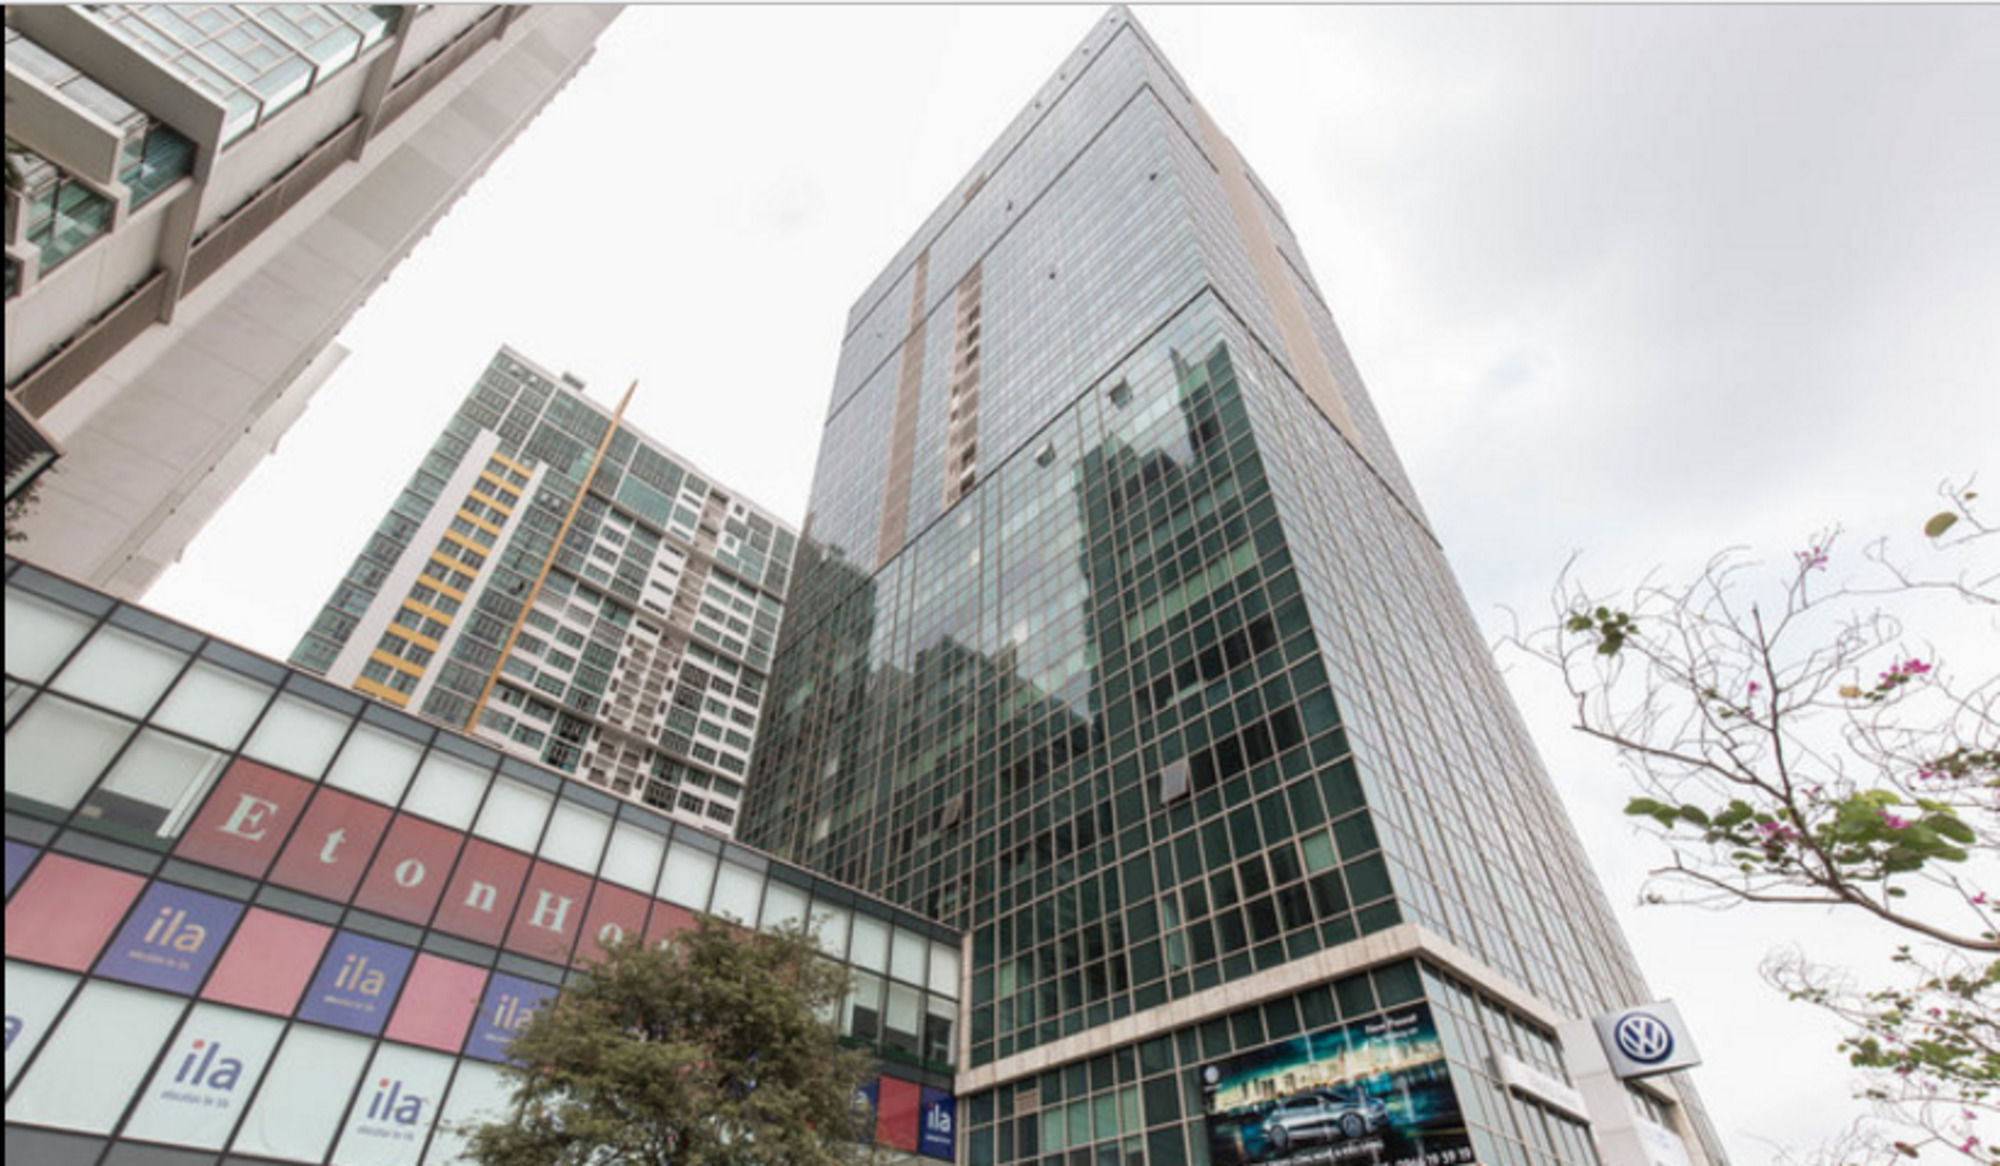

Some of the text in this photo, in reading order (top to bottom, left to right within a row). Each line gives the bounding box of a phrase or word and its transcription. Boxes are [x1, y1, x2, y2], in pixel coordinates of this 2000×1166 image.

[144, 907, 206, 953] ila
[335, 952, 385, 997] ila
[493, 993, 536, 1035] ila
[174, 1039, 243, 1091] ila
[367, 1077, 422, 1125] ila
[927, 1102, 952, 1133] ila
